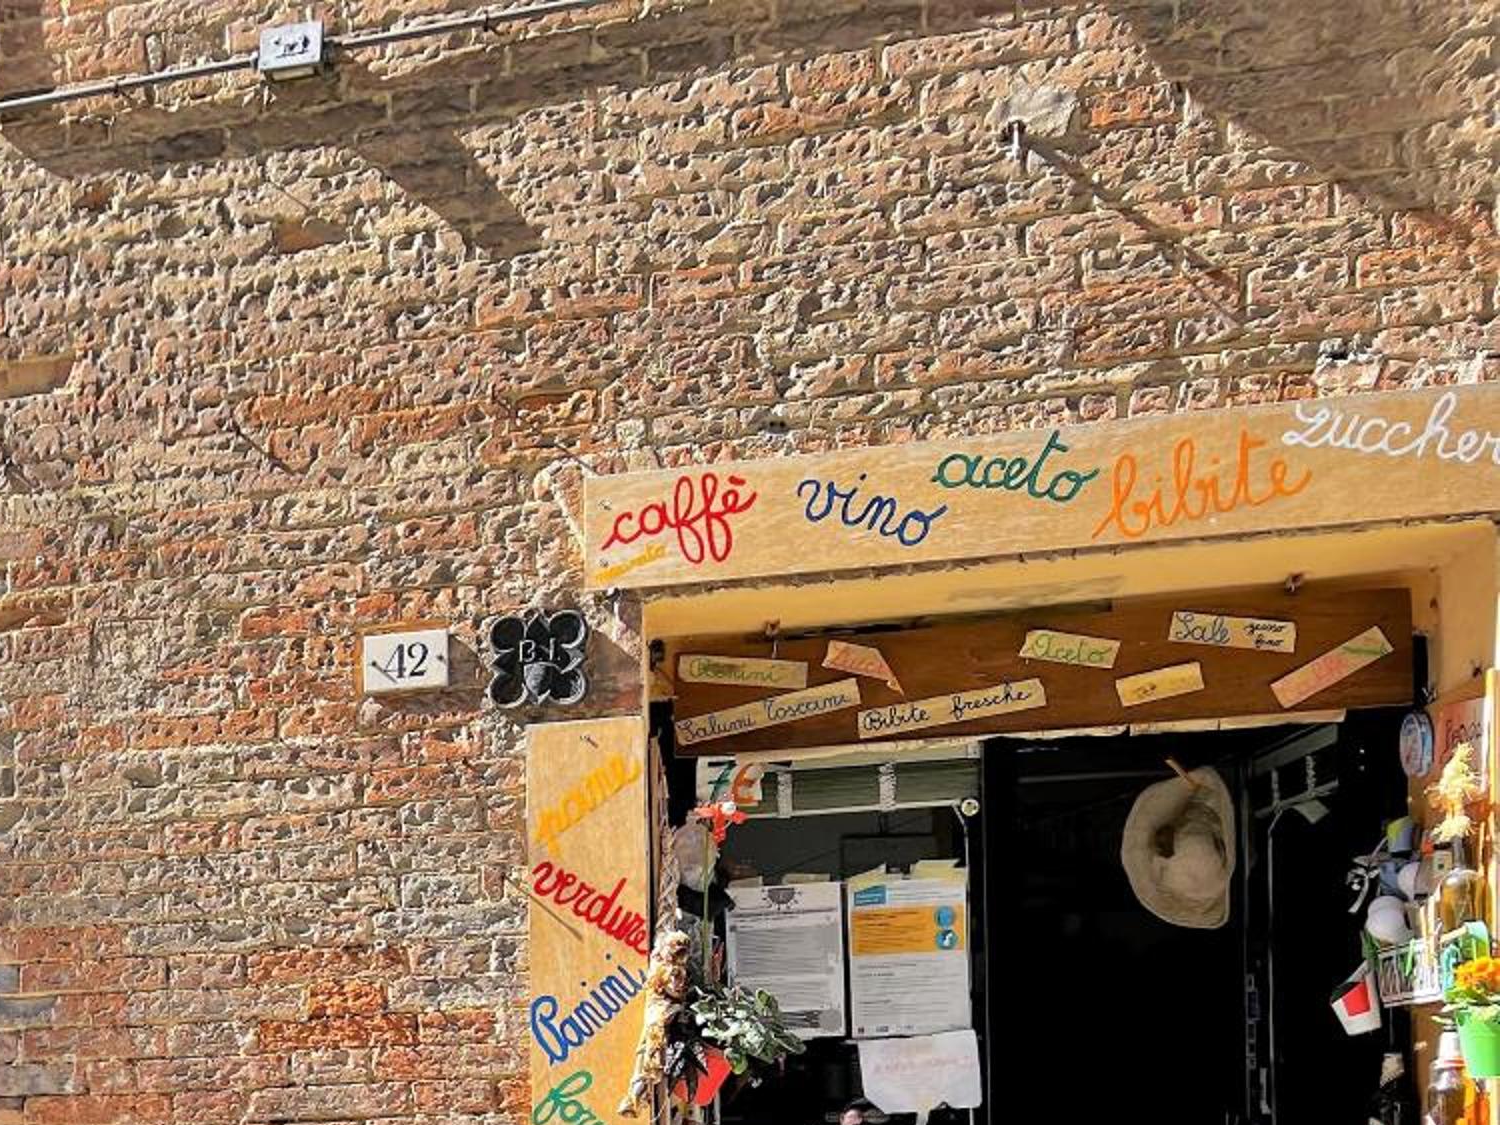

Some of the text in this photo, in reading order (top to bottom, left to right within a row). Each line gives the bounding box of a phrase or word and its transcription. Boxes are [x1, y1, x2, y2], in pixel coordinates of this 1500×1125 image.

[931, 430, 1100, 502] aceto
[1091, 428, 1313, 539] bibite
[601, 472, 758, 564] caffè
[797, 474, 949, 547] vino
[383, 641, 430, 679] 42
[1032, 632, 1113, 665] Aceto
[1173, 613, 1232, 645] Sale
[676, 713, 757, 741] Salumi
[862, 679, 1030, 732] Bibite fresche
[531, 861, 650, 956] verdure
